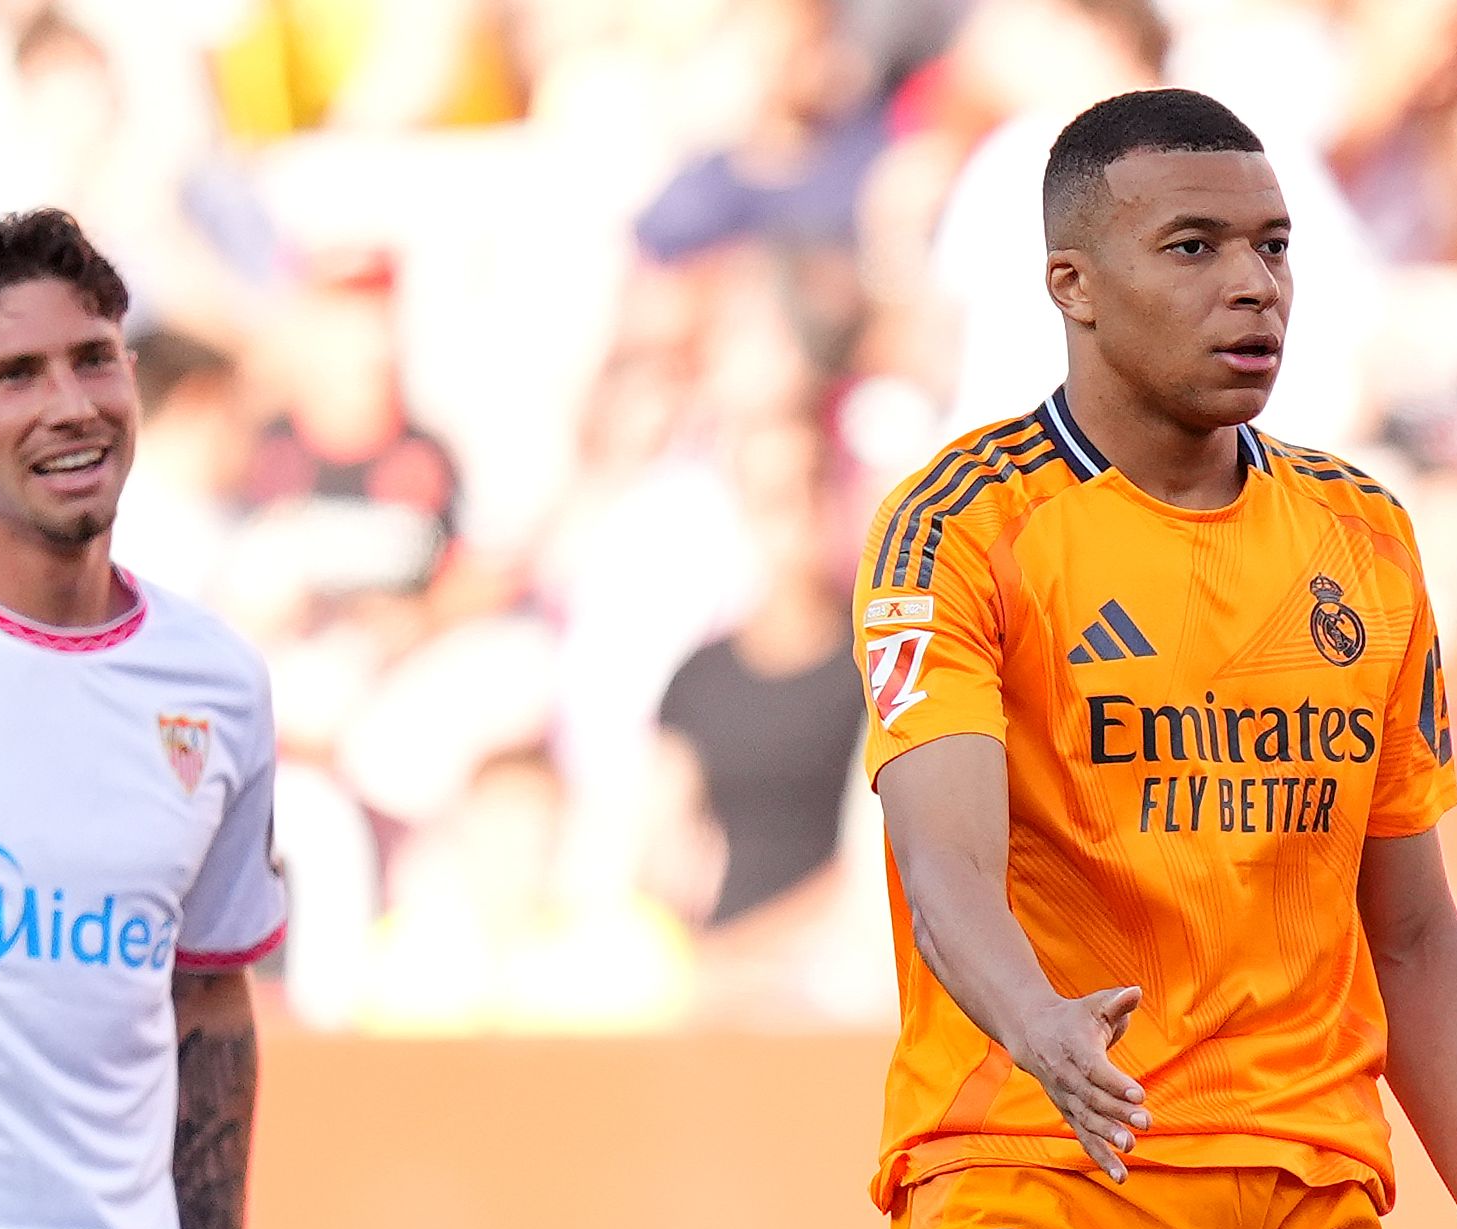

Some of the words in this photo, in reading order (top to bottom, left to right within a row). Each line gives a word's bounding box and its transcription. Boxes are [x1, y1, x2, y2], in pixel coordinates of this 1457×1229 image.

[1085, 691, 1377, 766] Emirates
[1140, 776, 1208, 834] FLY
[1220, 776, 1339, 834] BETTER
